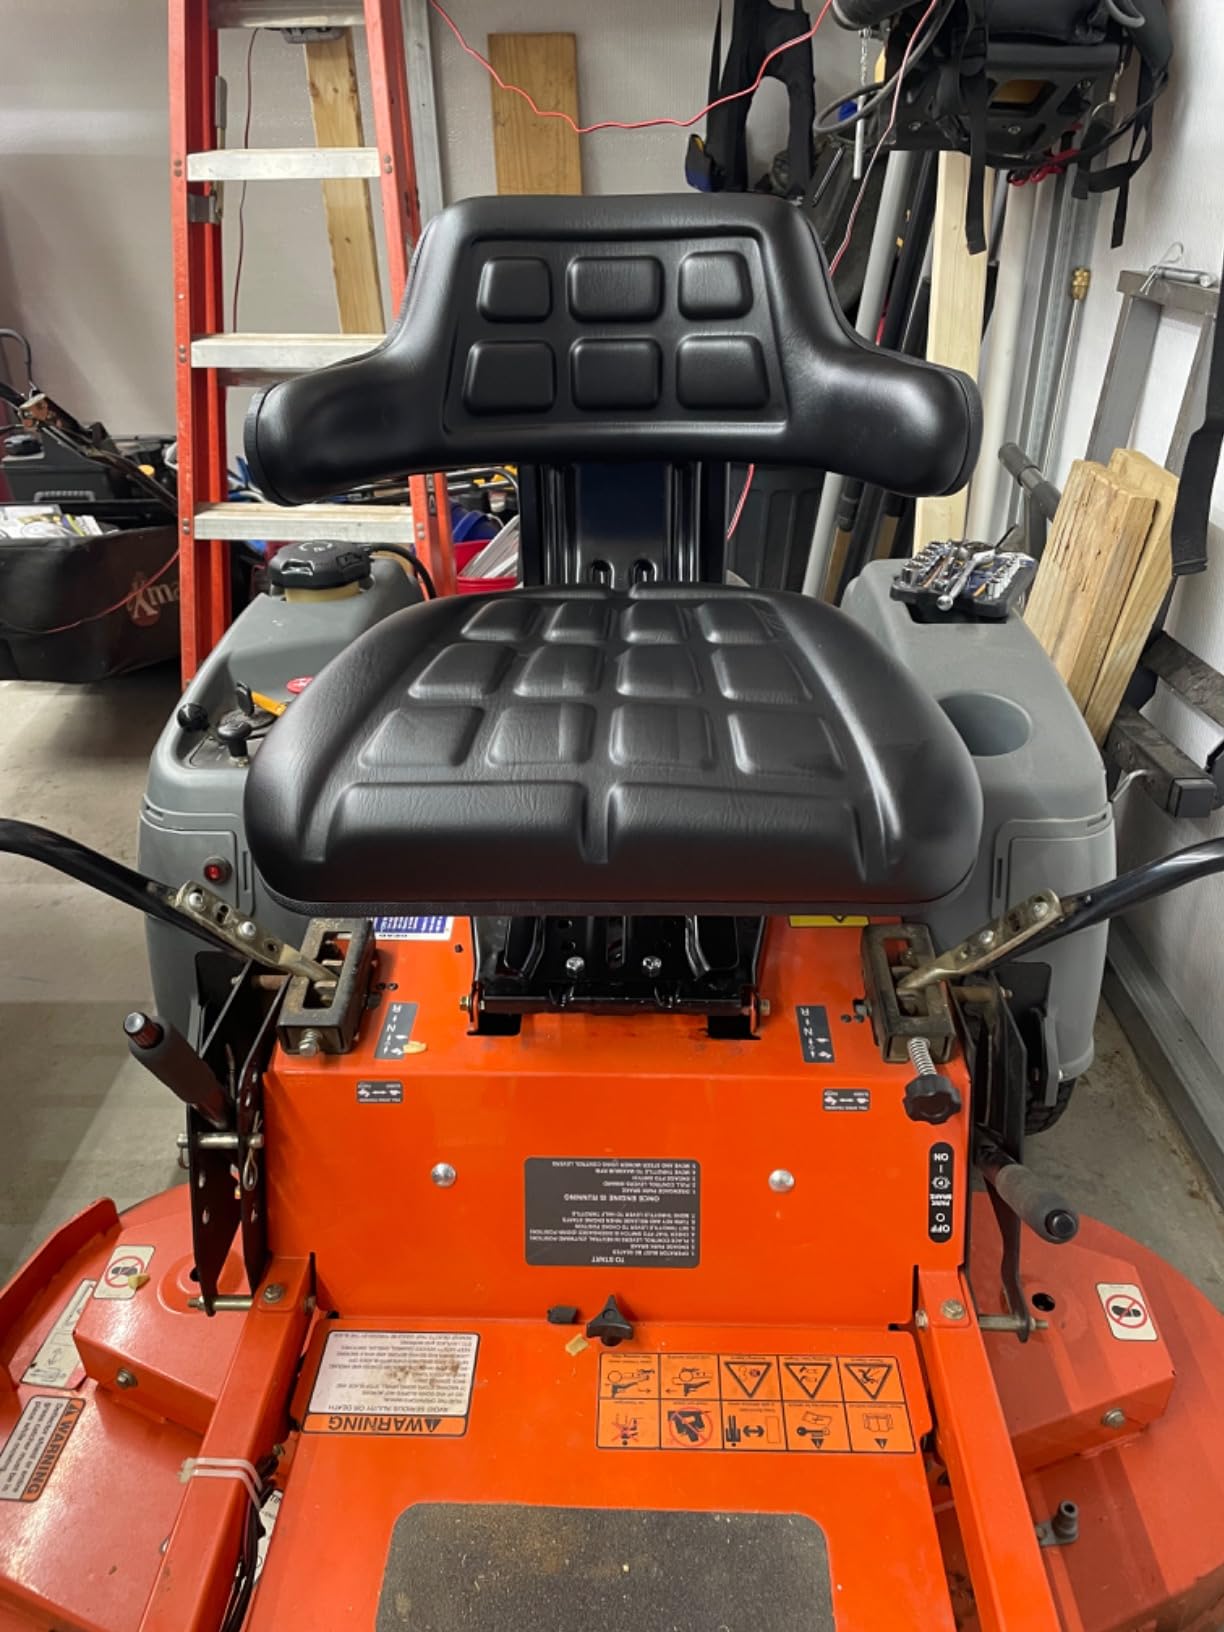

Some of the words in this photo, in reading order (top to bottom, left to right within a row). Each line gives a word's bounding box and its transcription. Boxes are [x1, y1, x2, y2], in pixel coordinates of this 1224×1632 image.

[392, 1004, 402, 1013] R
[386, 1024, 396, 1032] N
[803, 1028, 813, 1036] N
[328, 1415, 423, 1432] WARNING
[27, 1420, 72, 1494] WARNING
